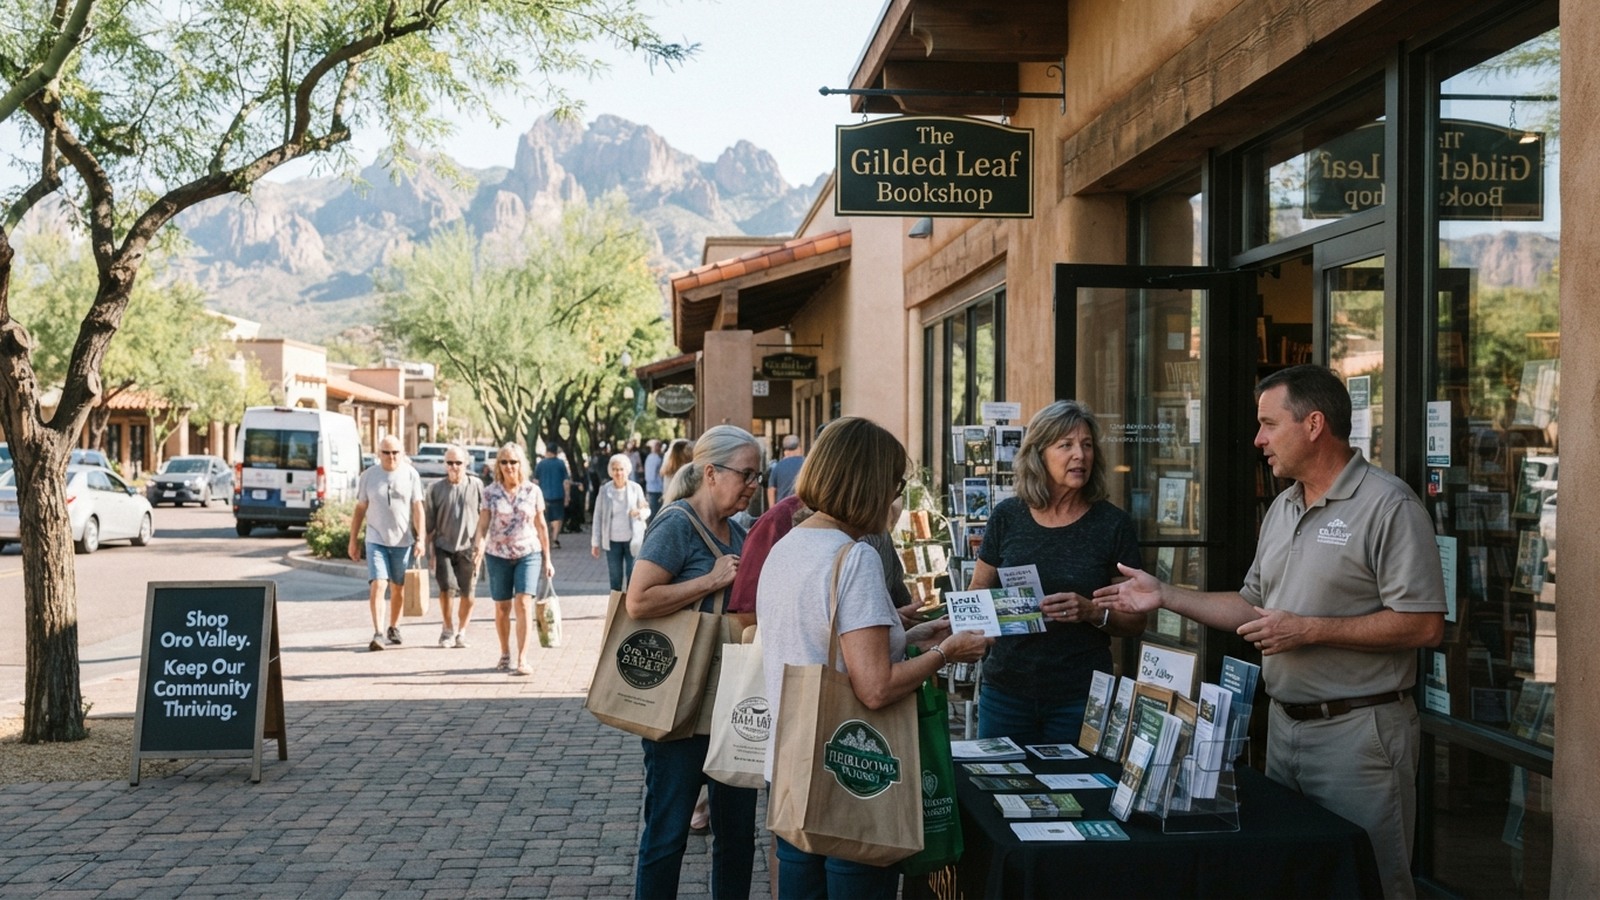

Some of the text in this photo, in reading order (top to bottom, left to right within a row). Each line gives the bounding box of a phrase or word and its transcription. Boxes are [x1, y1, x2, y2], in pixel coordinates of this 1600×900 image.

[916, 126, 954, 145] The
[851, 149, 1022, 177] Gilded Leaf
[876, 182, 993, 210] Bookshop
[186, 610, 229, 630] Shop
[160, 629, 251, 651] Oro Valley.
[163, 658, 245, 680] Keep Our
[153, 679, 251, 699] Community
[163, 700, 238, 721] Thriving.
